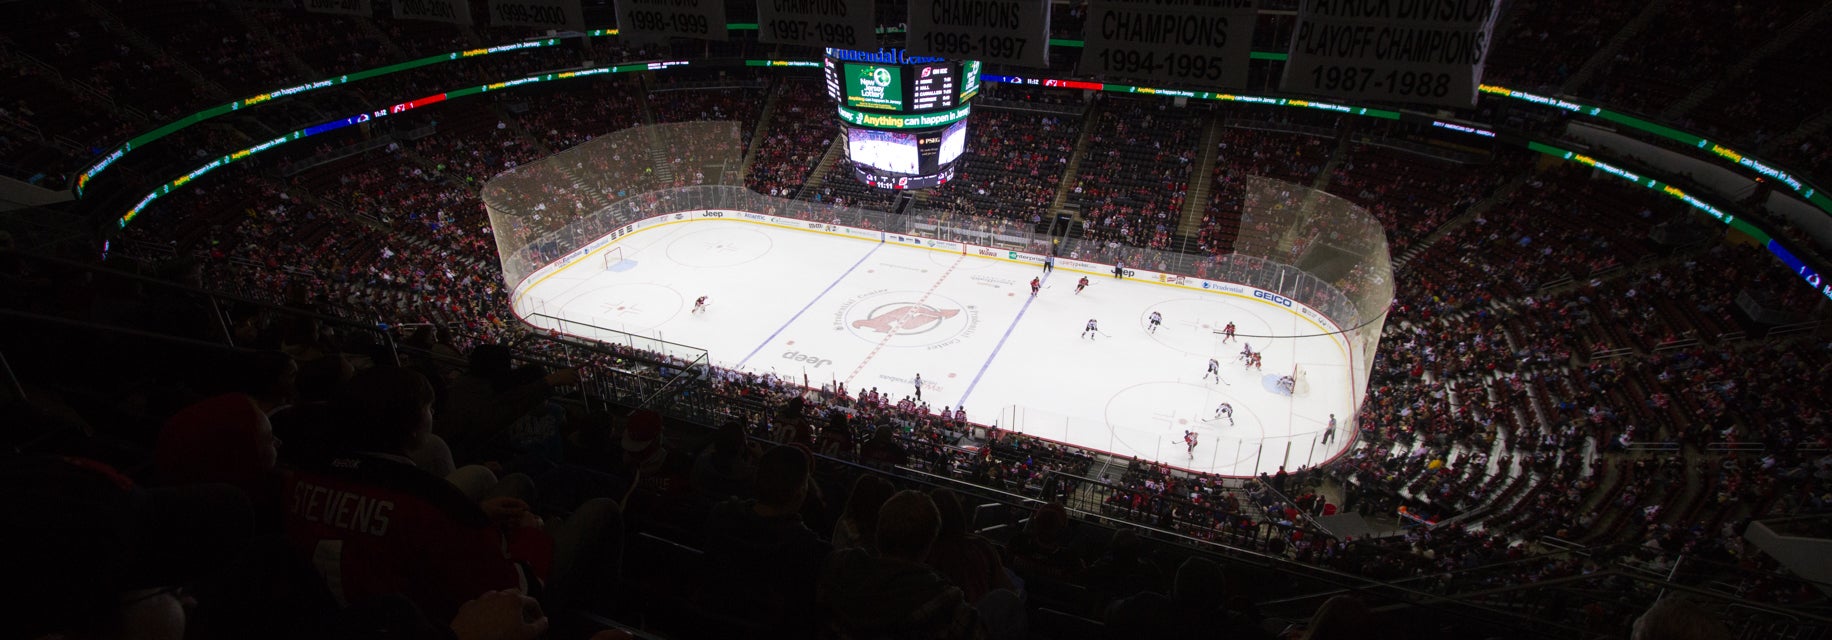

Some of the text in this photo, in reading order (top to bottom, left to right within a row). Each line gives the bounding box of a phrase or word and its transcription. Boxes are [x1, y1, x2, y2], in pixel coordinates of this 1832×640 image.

[496, 3, 567, 26] 1999-2000
[628, 11, 708, 35] 1998-1999
[931, 0, 1020, 30] CHAMPIONS
[769, 19, 856, 46] 1997-1998
[1102, 10, 1229, 49] CHAMPIONS
[463, 48, 488, 58] Anything
[498, 42, 517, 52] happen
[923, 32, 1027, 59] 1996-1997
[1296, 21, 1486, 66] PLAYOFF CHAMPIONS
[1100, 48, 1223, 81] 1994-1995
[1312, 65, 1452, 98] 1987-1988
[245, 93, 271, 106] Anything
[271, 90, 281, 98] can
[281, 84, 305, 97] happen
[861, 89, 885, 99] Lottery
[1478, 83, 1511, 97] Anything
[1510, 90, 1523, 98] can
[1523, 92, 1549, 103] happen
[863, 114, 904, 128] Anything
[904, 116, 920, 126] can
[920, 112, 950, 126] happen
[950, 110, 957, 120] in
[1712, 144, 1742, 163] Anything
[1741, 157, 1753, 168] can
[1752, 160, 1779, 178] happen
[877, 180, 893, 190] 11:11
[702, 209, 724, 218] Jeep
[978, 247, 998, 257] Wawa
[1212, 282, 1244, 294] Prudential
[1253, 289, 1292, 308] GEICO
[782, 351, 833, 369] Jeep
[291, 480, 395, 537] STEVENS
